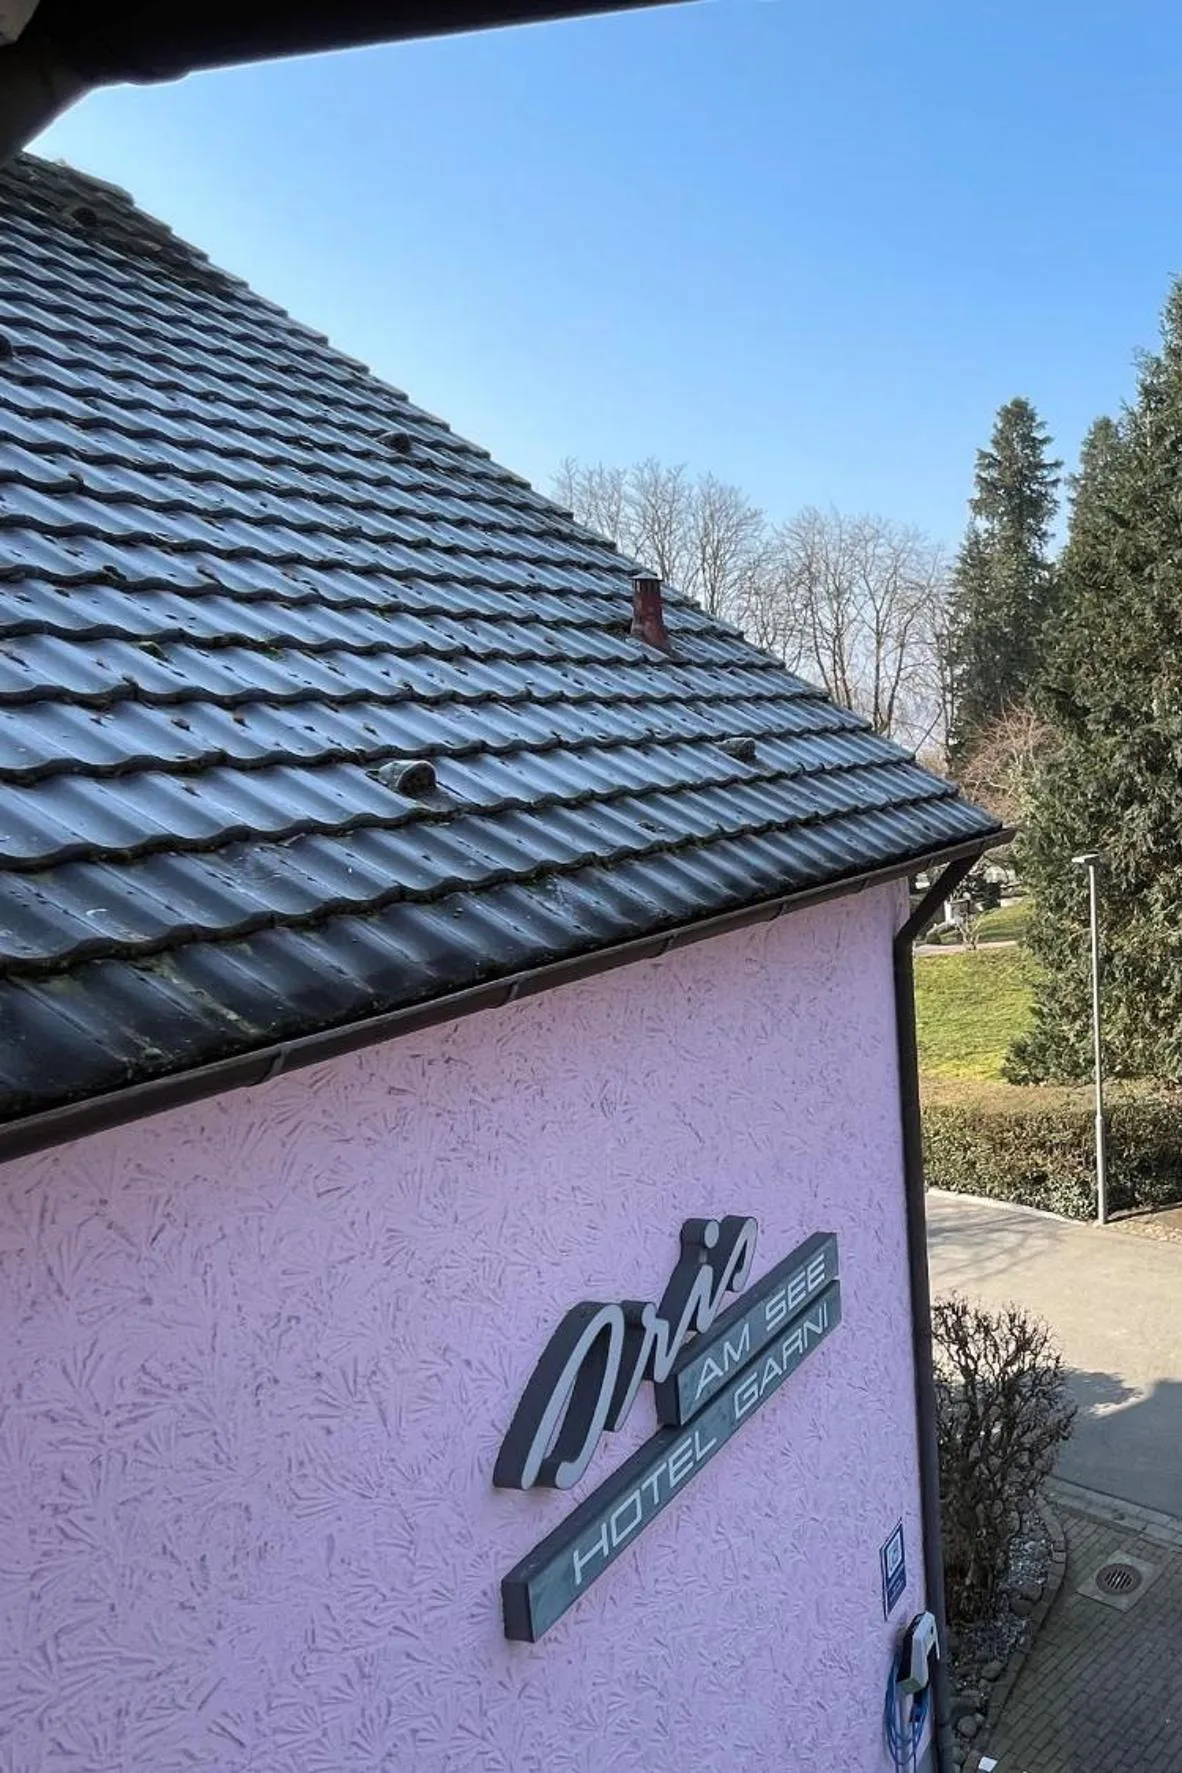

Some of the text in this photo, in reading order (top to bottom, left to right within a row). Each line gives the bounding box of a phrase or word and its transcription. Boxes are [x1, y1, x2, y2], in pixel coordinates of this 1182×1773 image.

[694, 1253, 826, 1401] AM SEE
[573, 1302, 829, 1586] HOTEL GARNI
